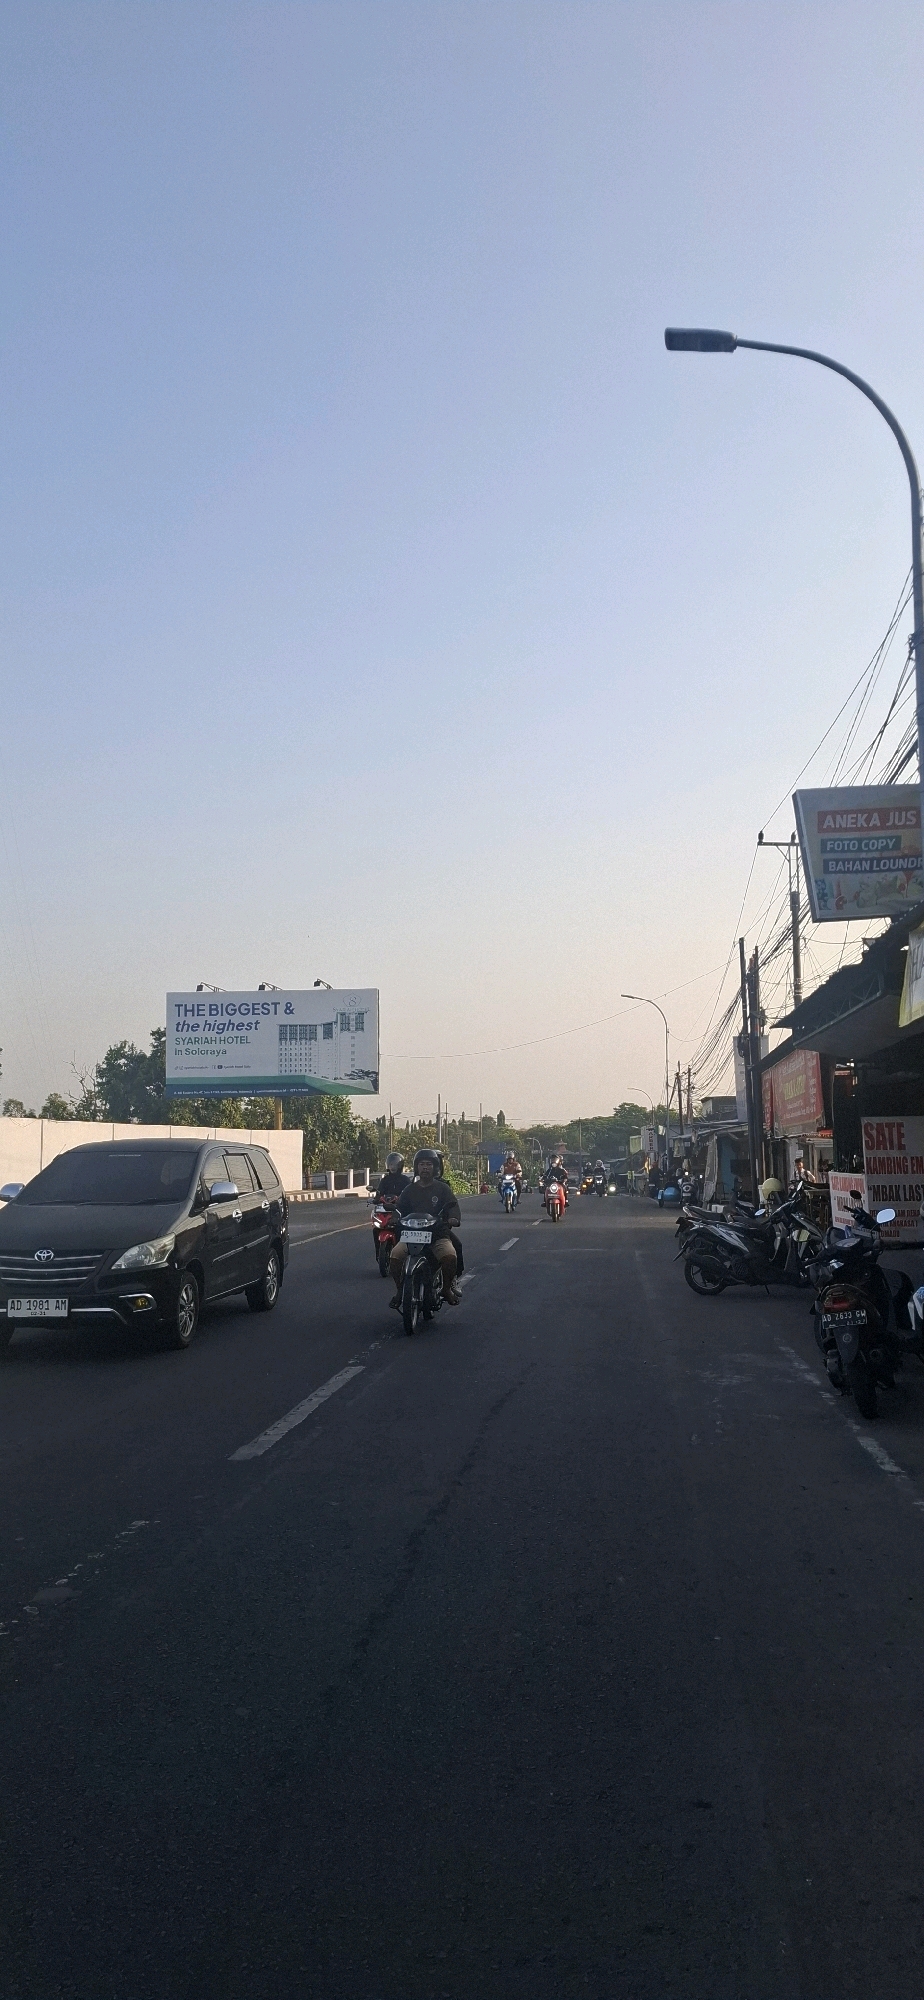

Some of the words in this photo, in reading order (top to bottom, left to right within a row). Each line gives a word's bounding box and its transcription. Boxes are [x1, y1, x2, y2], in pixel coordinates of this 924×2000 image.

[822, 813, 881, 829] ANEKA
[886, 810, 917, 826] JUS
[826, 840, 858, 851] FOTO
[861, 838, 896, 851] COPY
[828, 860, 870, 872] BAHAN
[174, 1003, 206, 1018] THE
[208, 1001, 281, 1017] BIGGEST
[284, 1001, 295, 1015] &
[175, 1019, 200, 1033] the
[202, 1019, 261, 1035] highest
[174, 1036, 218, 1046] SYARIAH
[219, 1035, 252, 1045] HOTEL
[184, 1047, 228, 1058] Soloraya
[863, 1121, 906, 1151] SATE
[865, 1156, 909, 1175] KAMBING
[910, 1156, 924, 1175] EM
[10, 1299, 22, 1311] AD
[26, 1299, 50, 1311] 1981
[55, 1299, 67, 1311] AM
[822, 1314, 832, 1322] AD
